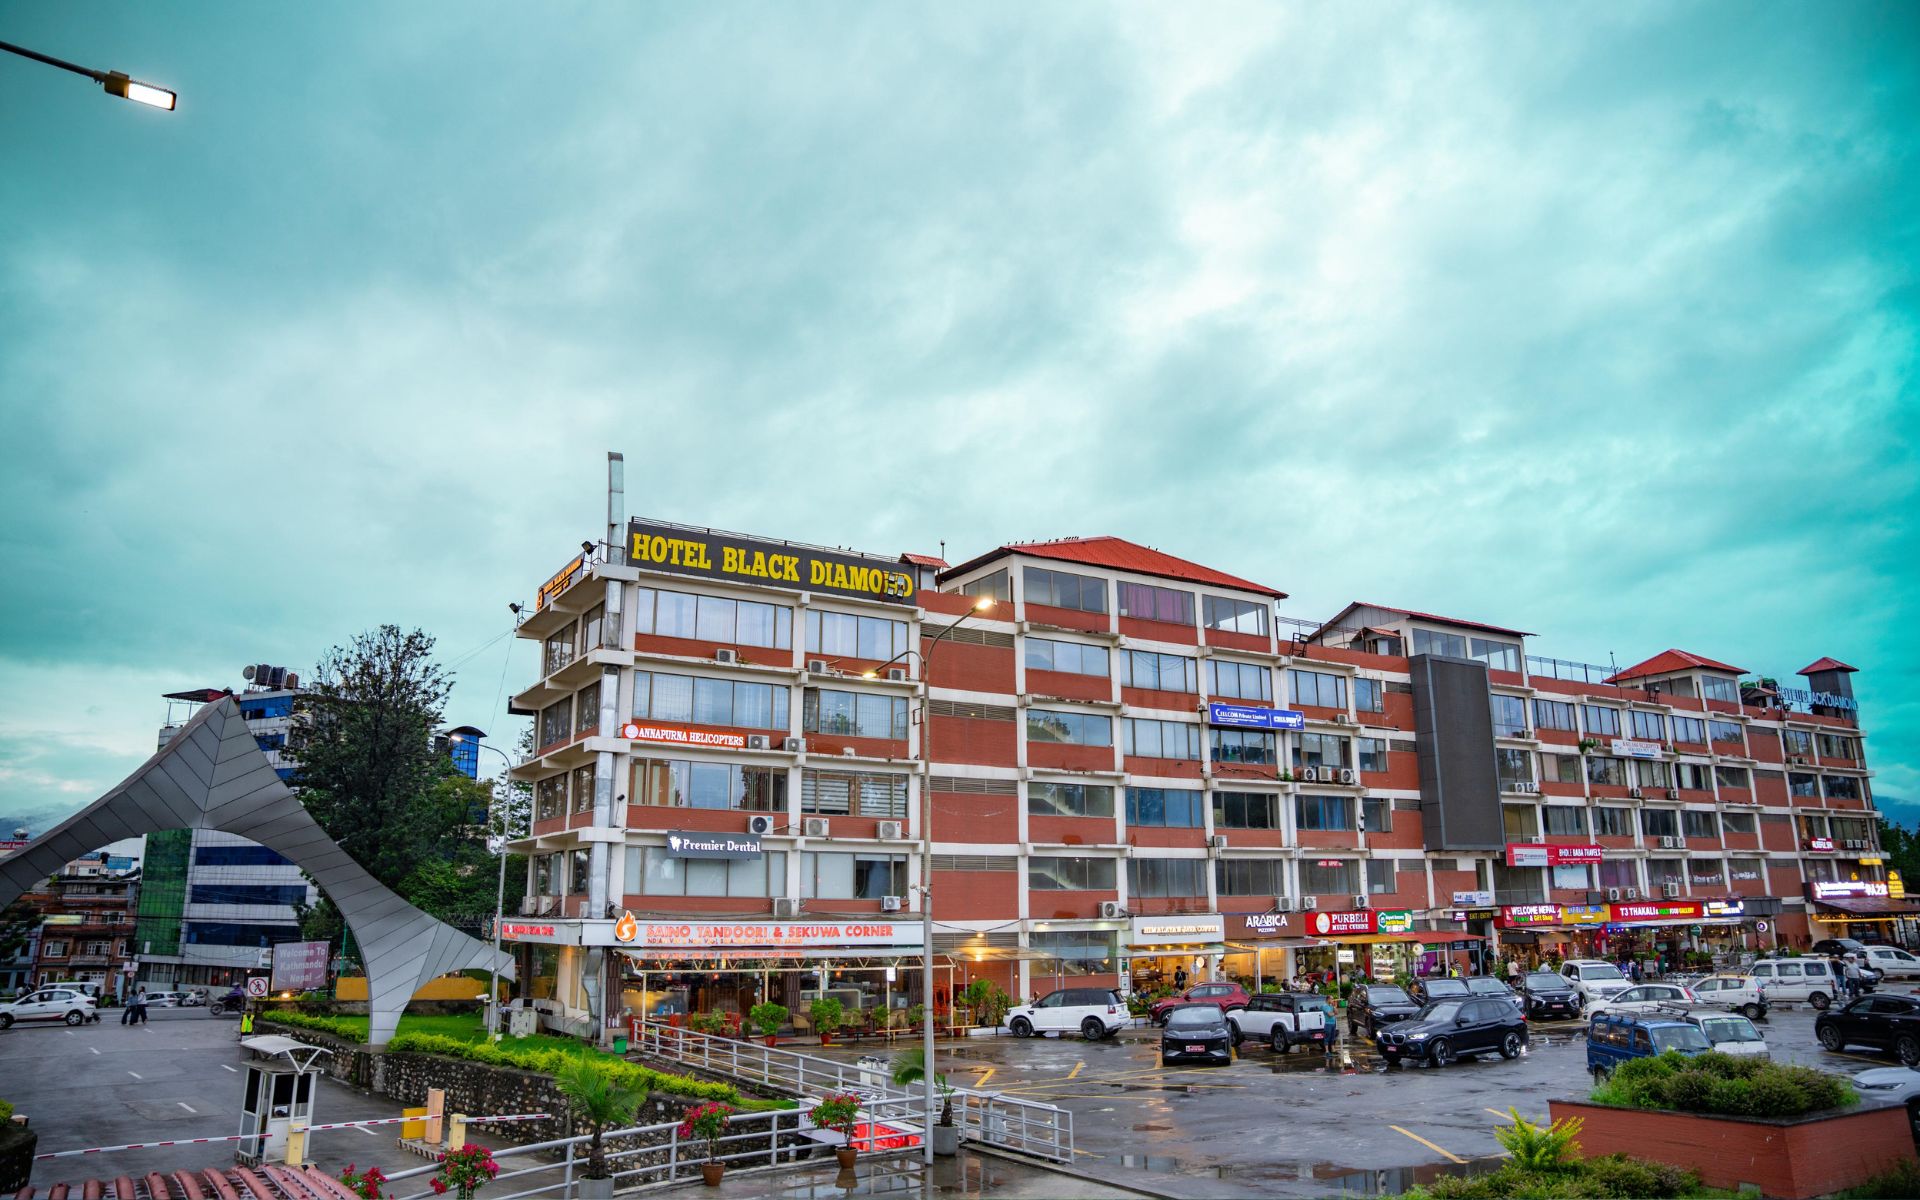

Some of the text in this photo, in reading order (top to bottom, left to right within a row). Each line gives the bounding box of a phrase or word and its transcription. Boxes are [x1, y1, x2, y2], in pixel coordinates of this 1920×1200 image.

[631, 533, 712, 570] HOTEL
[722, 546, 800, 582] BLACK
[638, 727, 744, 746] ANNAPURNA HELICOPTERS
[683, 838, 760, 852] Premier Dental
[1573, 848, 1584, 857] BABA
[1584, 848, 1601, 857] TRAVELS
[1511, 905, 1556, 915] WELCOME NEPAL
[1620, 908, 1628, 916] T3
[1629, 907, 1656, 916] THAKALI
[1246, 915, 1288, 928] ARABICA
[1331, 913, 1368, 923] PURBELI
[646, 925, 894, 938] SAINO TANDOORI & SEKUWA CORNER
[280, 948, 314, 958] Welcome
[281, 960, 323, 970] Kathmandu
[290, 973, 312, 983] Nepal
